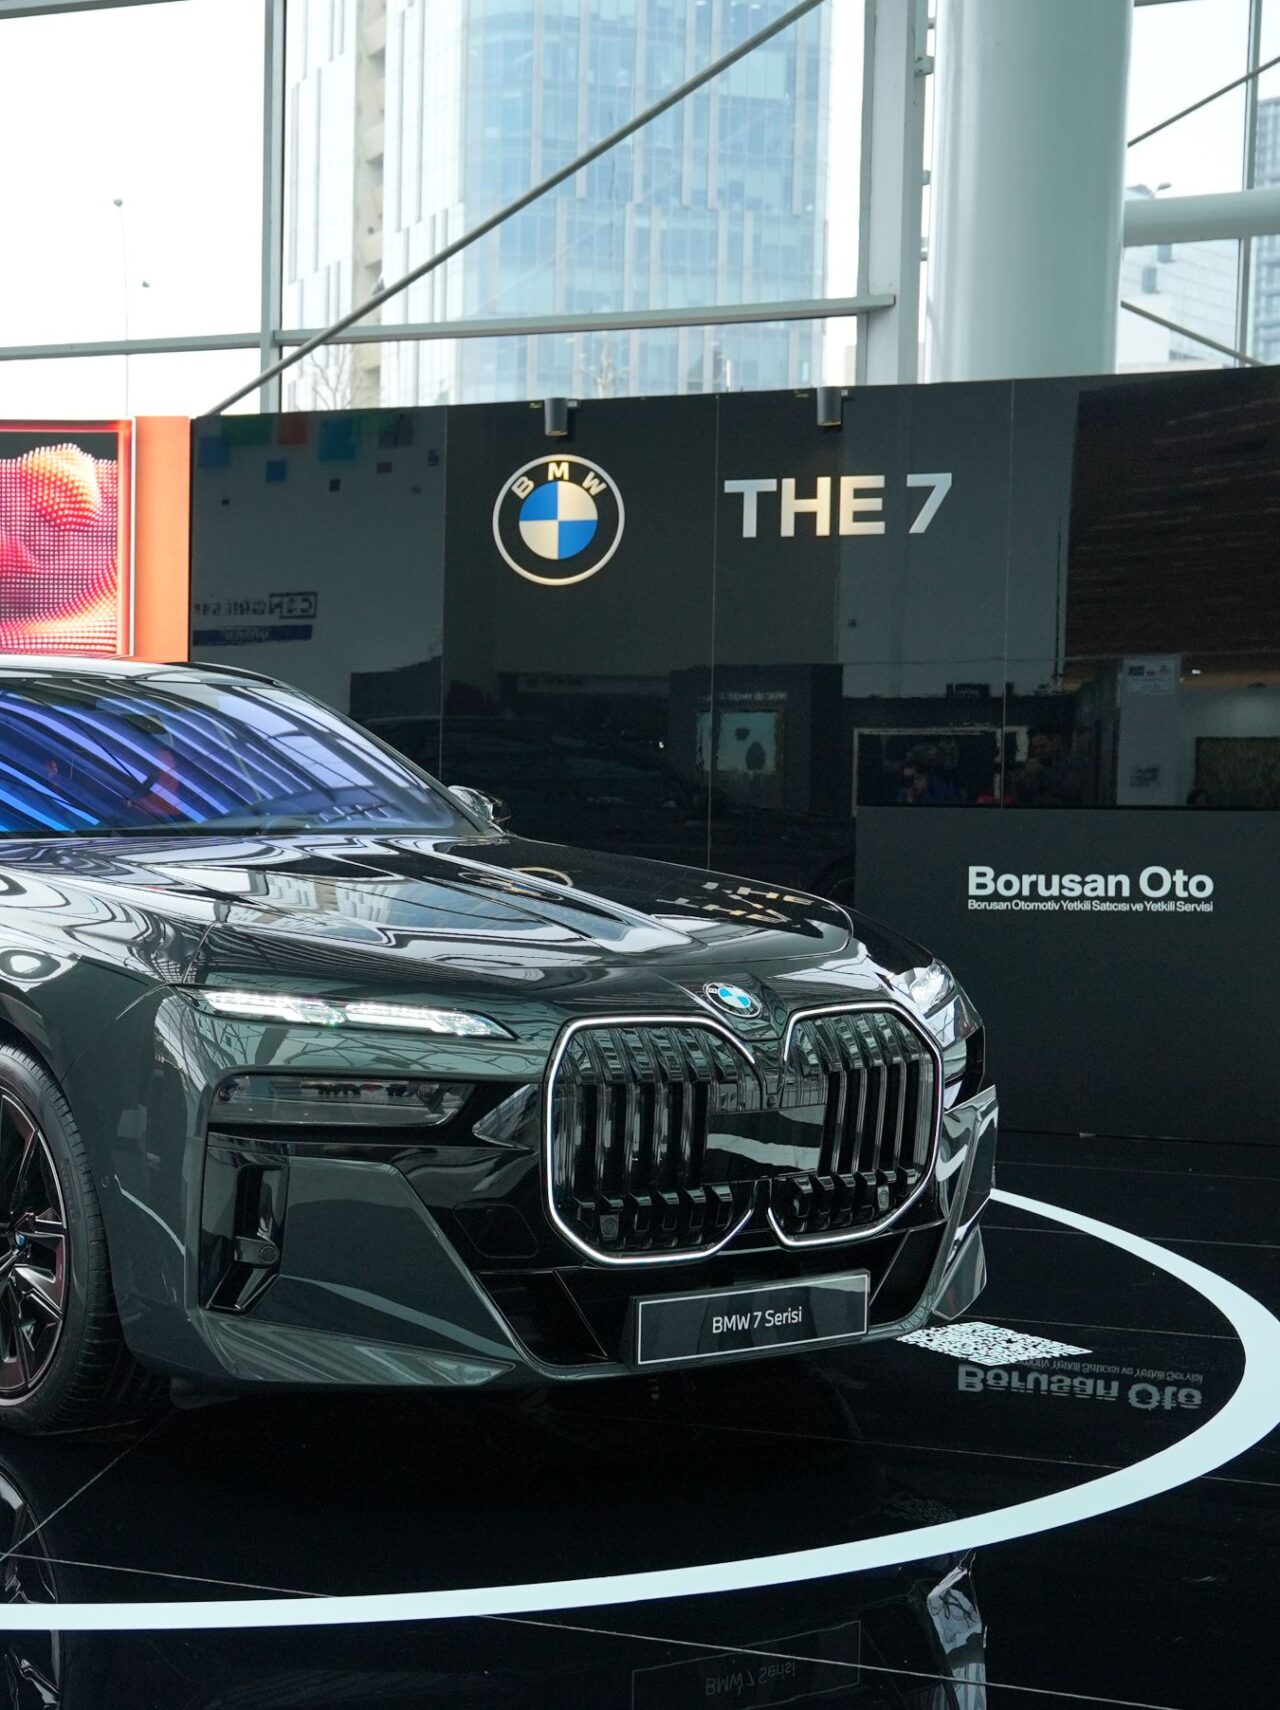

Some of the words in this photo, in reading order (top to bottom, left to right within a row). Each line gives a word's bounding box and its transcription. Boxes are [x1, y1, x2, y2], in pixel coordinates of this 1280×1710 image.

[511, 462, 607, 499] BMW
[724, 475, 886, 538] THE
[906, 472, 953, 534] 7
[968, 865, 1130, 898] Borusan
[1139, 865, 1214, 898] Oto
[968, 899, 1011, 910] Borusan
[1012, 899, 1060, 910] Otomotiv
[1060, 900, 1091, 911] Yetkili
[1092, 900, 1129, 911] Satıcısı
[1131, 902, 1143, 912] ve
[1144, 900, 1175, 912] Yetkili
[1176, 900, 1213, 912] Servisi
[712, 1312, 750, 1334] BMW
[753, 1311, 762, 1329] 7
[765, 1306, 802, 1327] Serisi
